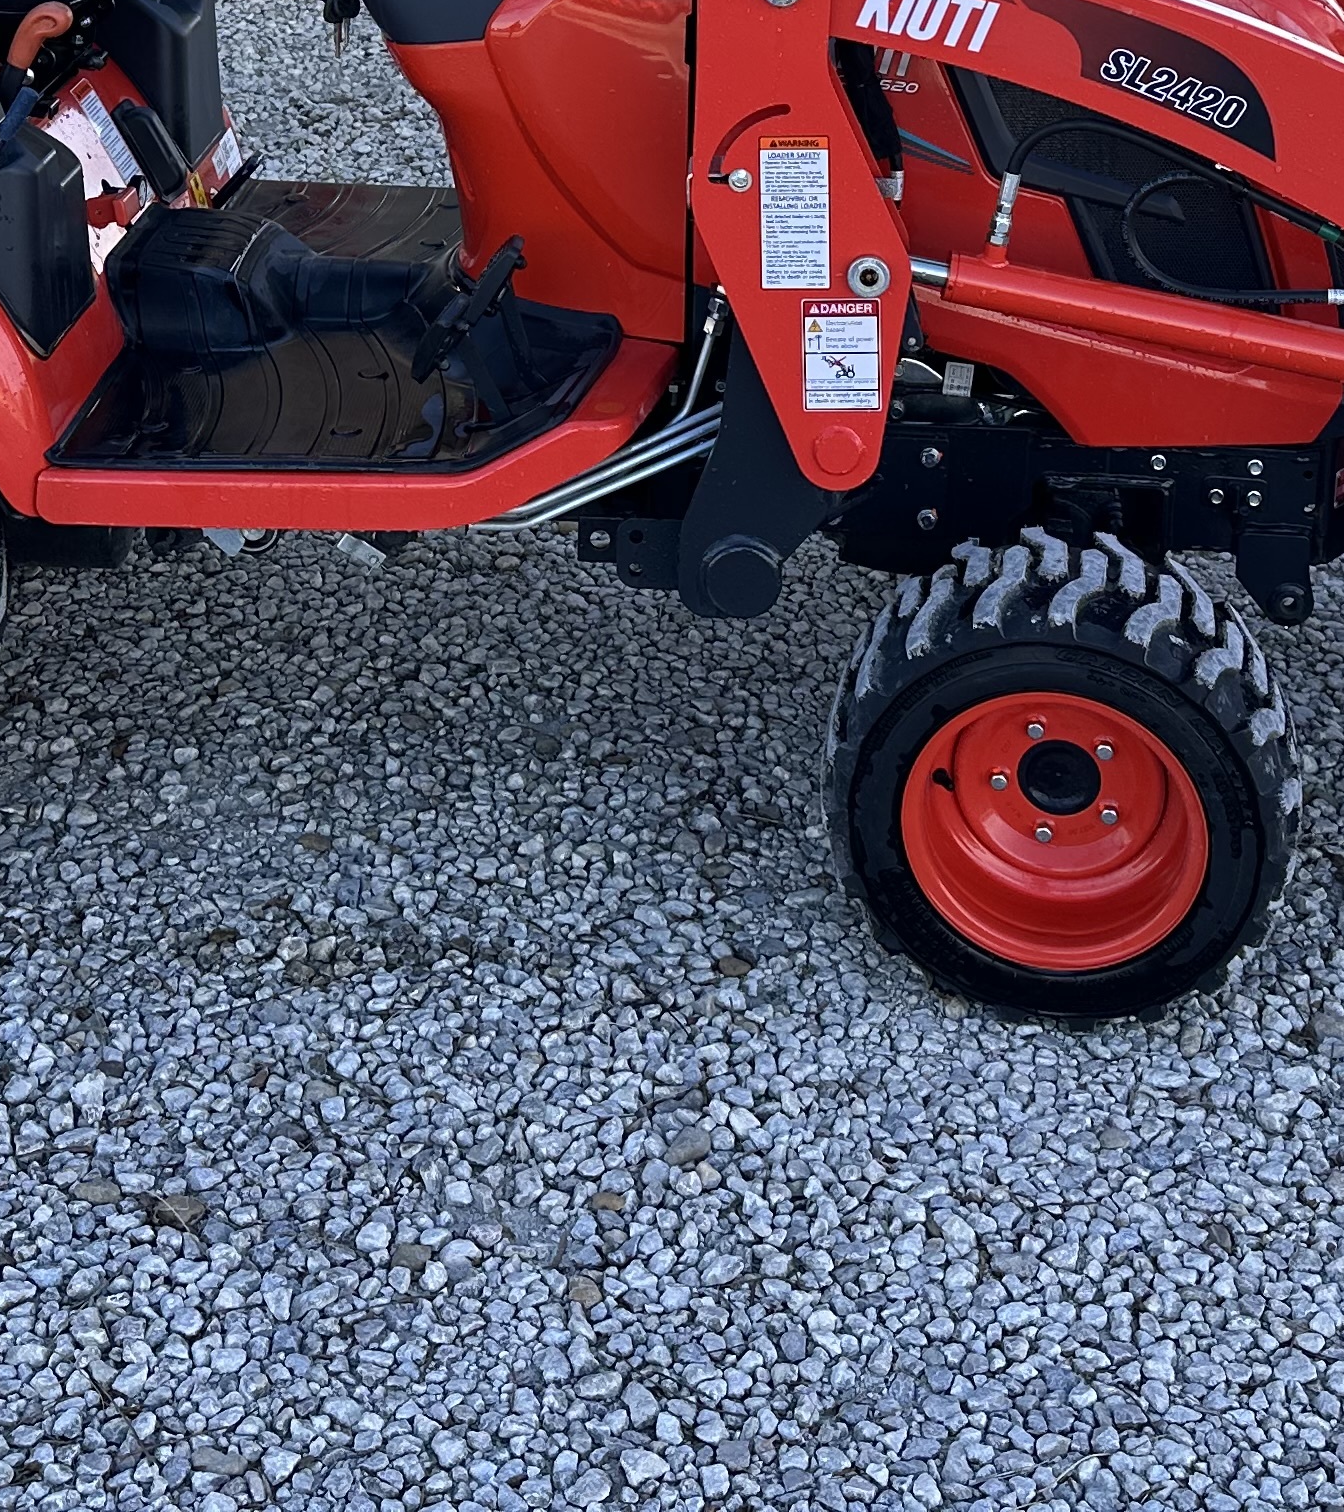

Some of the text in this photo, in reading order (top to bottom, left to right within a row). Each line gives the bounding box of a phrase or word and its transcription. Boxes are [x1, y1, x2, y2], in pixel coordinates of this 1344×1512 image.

[1099, 48, 1248, 130] SL2420
[777, 139, 820, 148] WARNING
[820, 303, 873, 314] DANGER
